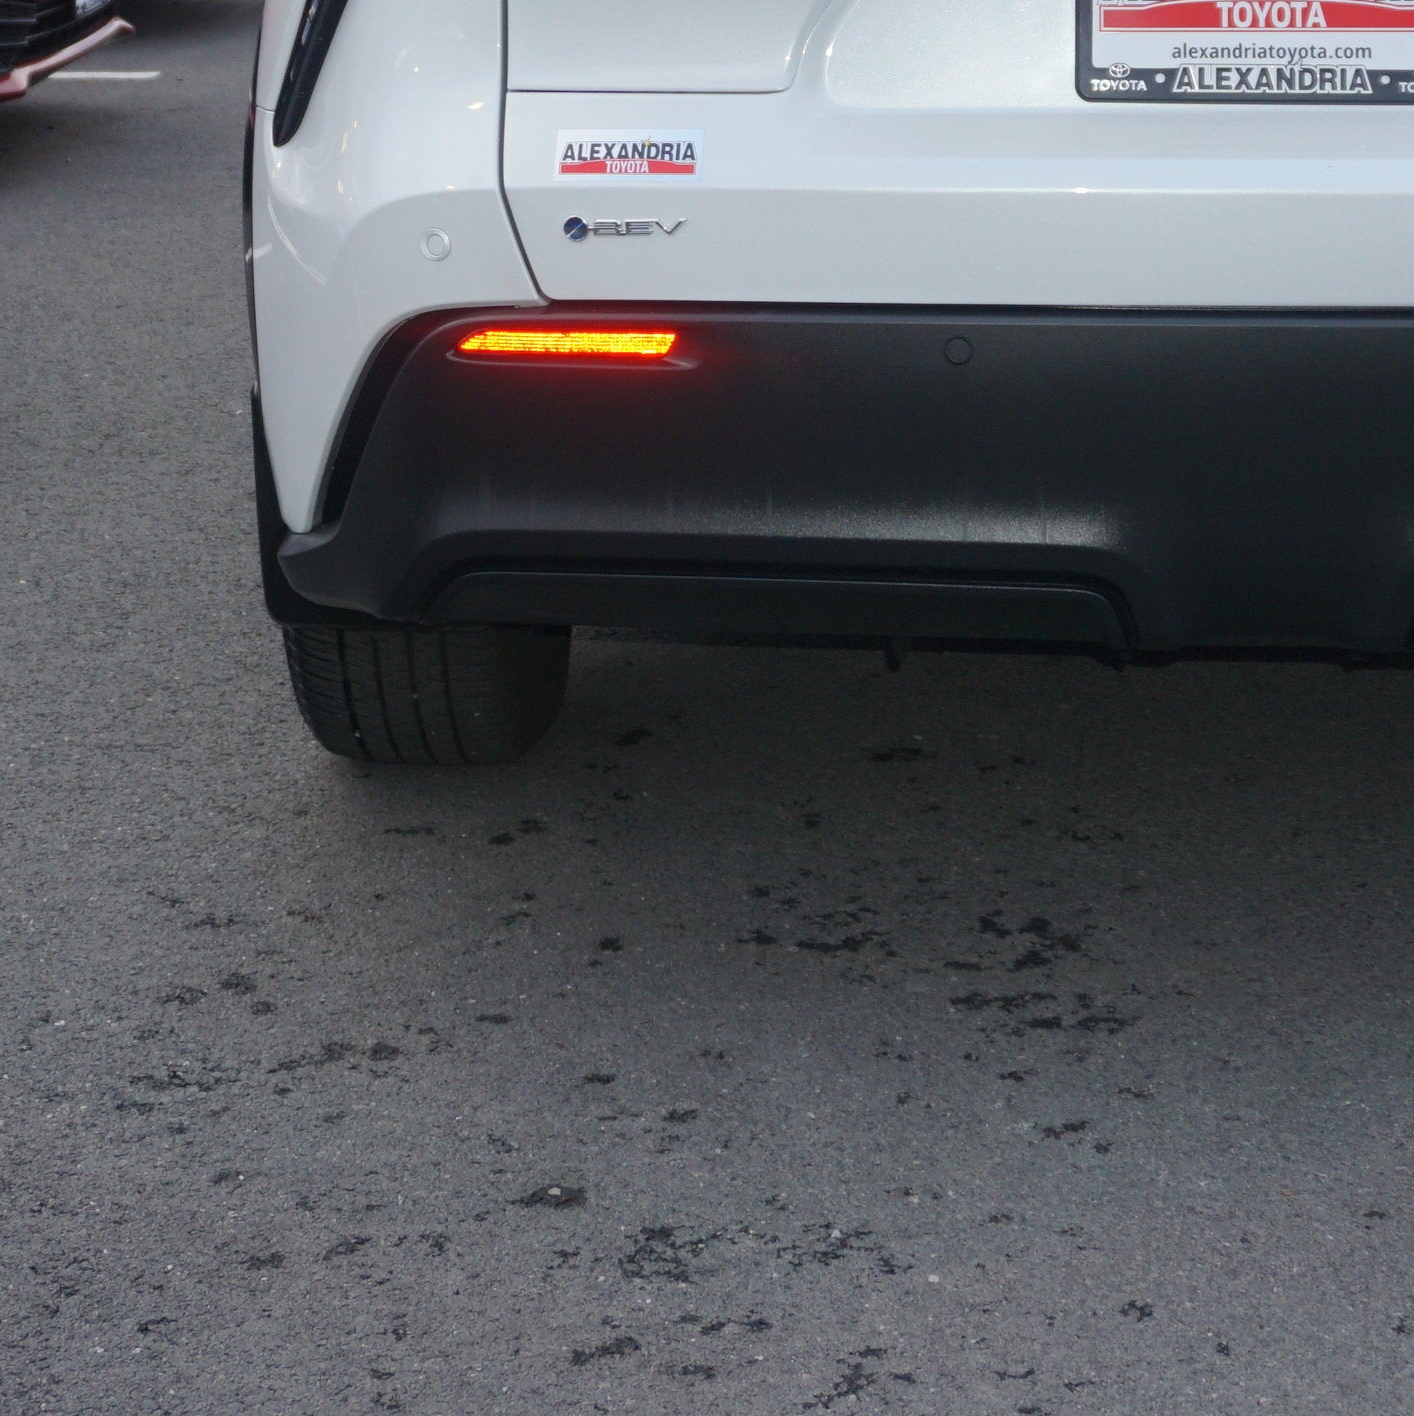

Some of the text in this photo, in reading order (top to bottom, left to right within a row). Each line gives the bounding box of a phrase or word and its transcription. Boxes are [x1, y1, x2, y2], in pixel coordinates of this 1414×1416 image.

[1217, 1, 1328, 28] TOYOTA
[1172, 43, 1372, 64] alexandriatoyota.com
[1091, 79, 1147, 92] TOYOTA
[1173, 65, 1373, 94] ALEXANDRIA
[562, 142, 696, 161] ALEXANDRIA
[605, 160, 649, 174] TOYOTA
[592, 218, 687, 236] BEV
